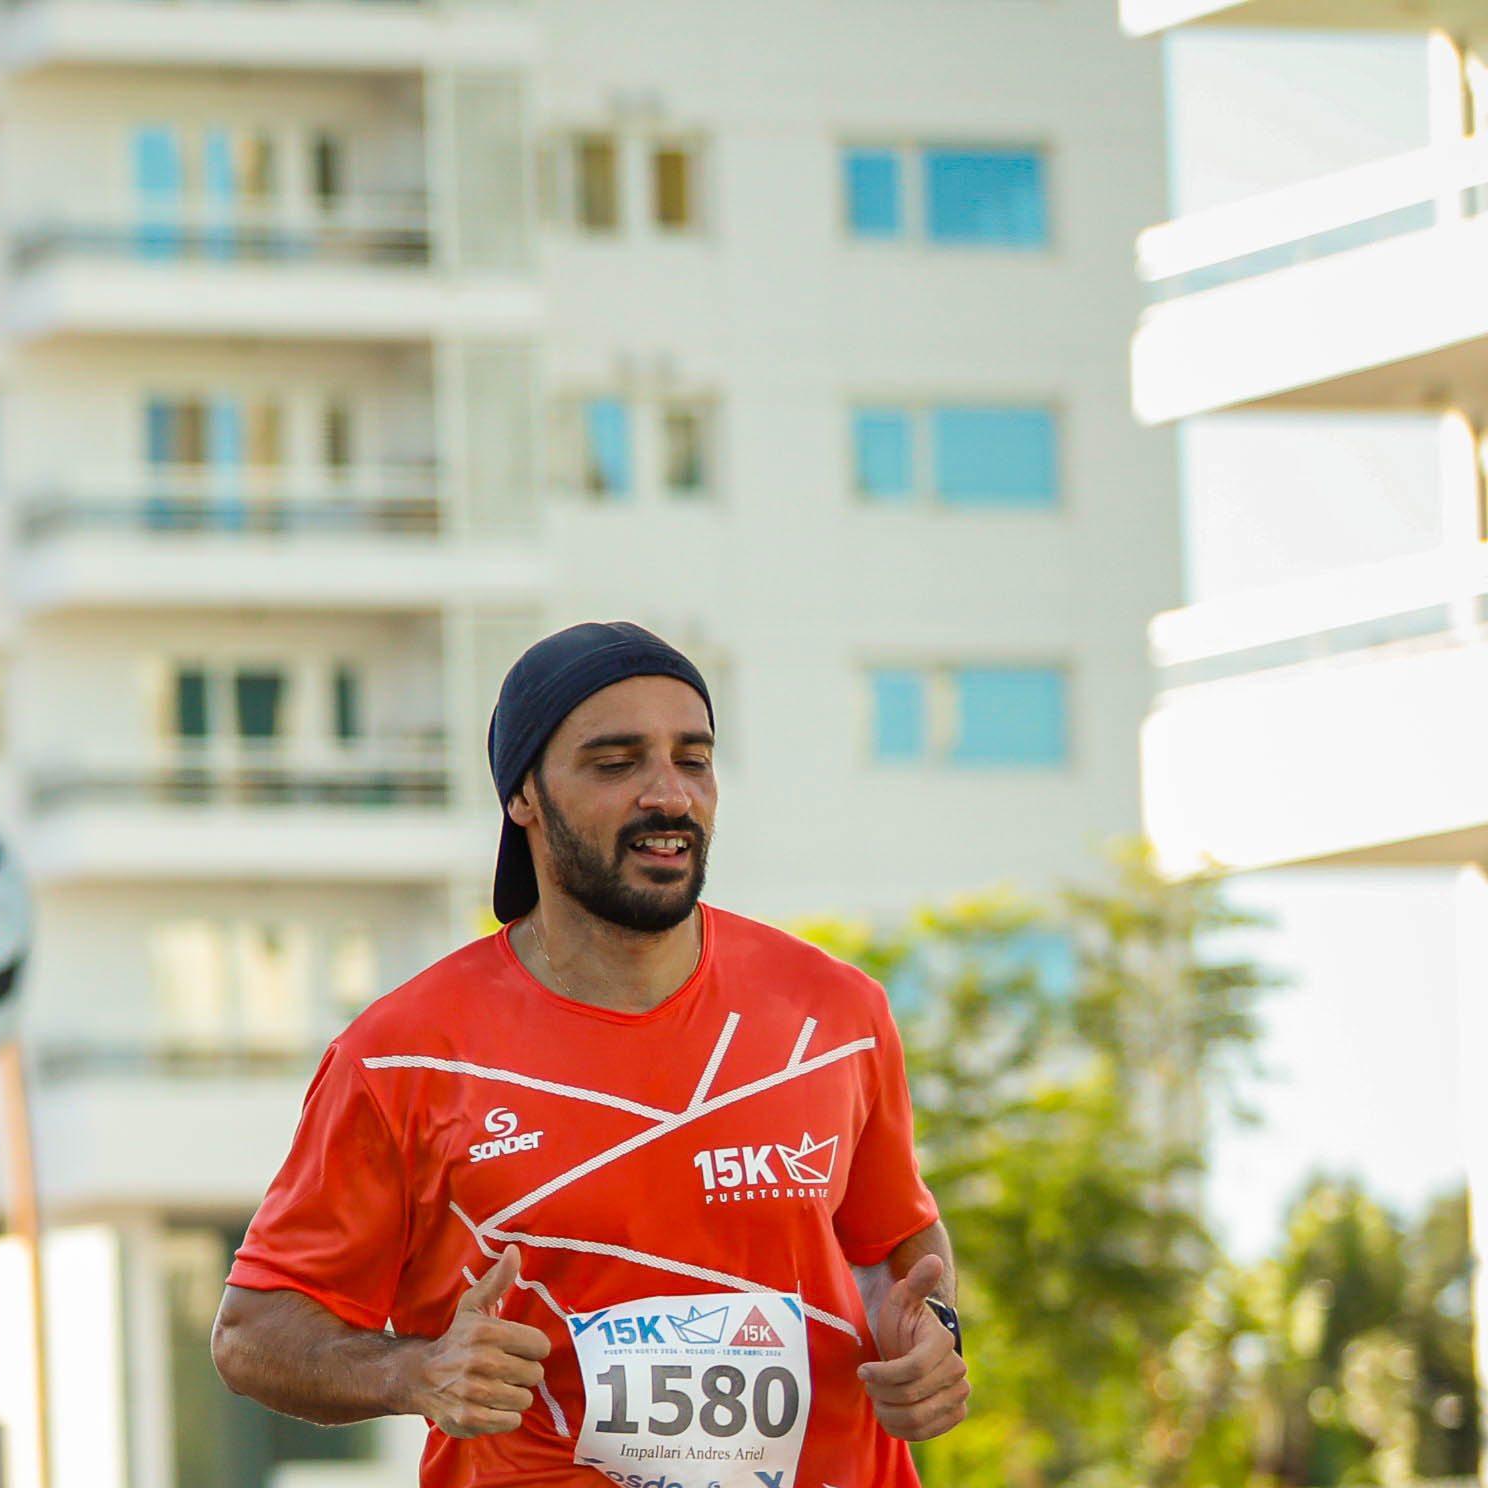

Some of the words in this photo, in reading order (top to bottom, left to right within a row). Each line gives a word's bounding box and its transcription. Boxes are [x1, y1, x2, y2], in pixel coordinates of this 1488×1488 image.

[693, 1144, 779, 1190] 15K
[705, 1189, 780, 1204] PUERTO
[786, 1188, 829, 1199] NORTE
[597, 1315, 666, 1345] 15K
[741, 1324, 773, 1343] 15K
[595, 1364, 800, 1439] 1580
[620, 1443, 681, 1461] Impallari
[685, 1446, 730, 1460] Andres
[734, 1447, 765, 1461] Ariel
